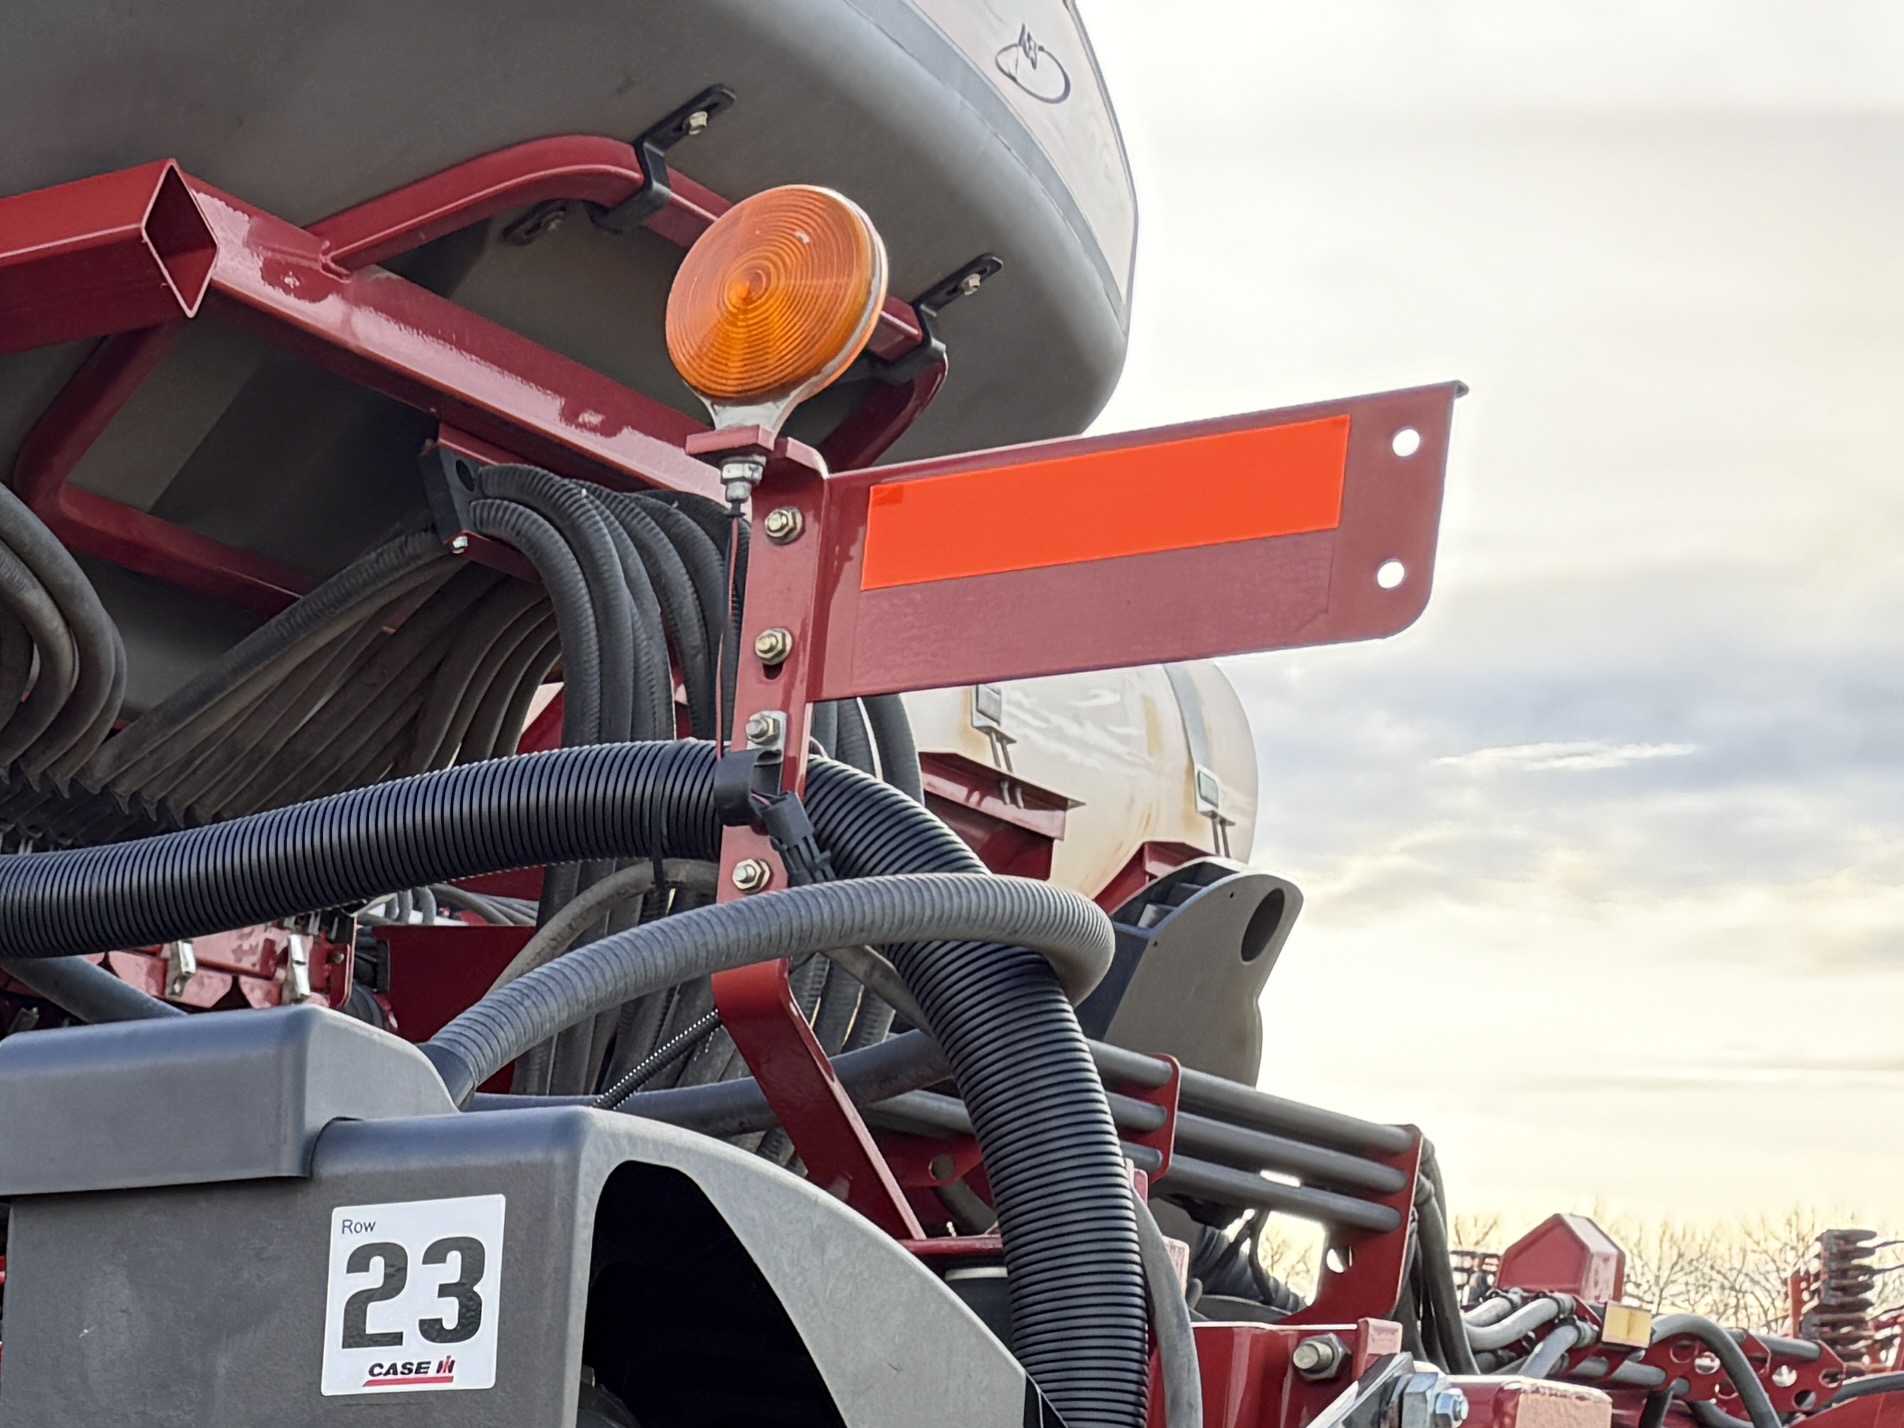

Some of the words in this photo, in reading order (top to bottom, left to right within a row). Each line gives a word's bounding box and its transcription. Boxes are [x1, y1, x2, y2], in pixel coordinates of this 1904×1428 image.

[342, 1219, 376, 1235] Row
[342, 1236, 486, 1349] 23
[368, 1361, 432, 1377] CASE
